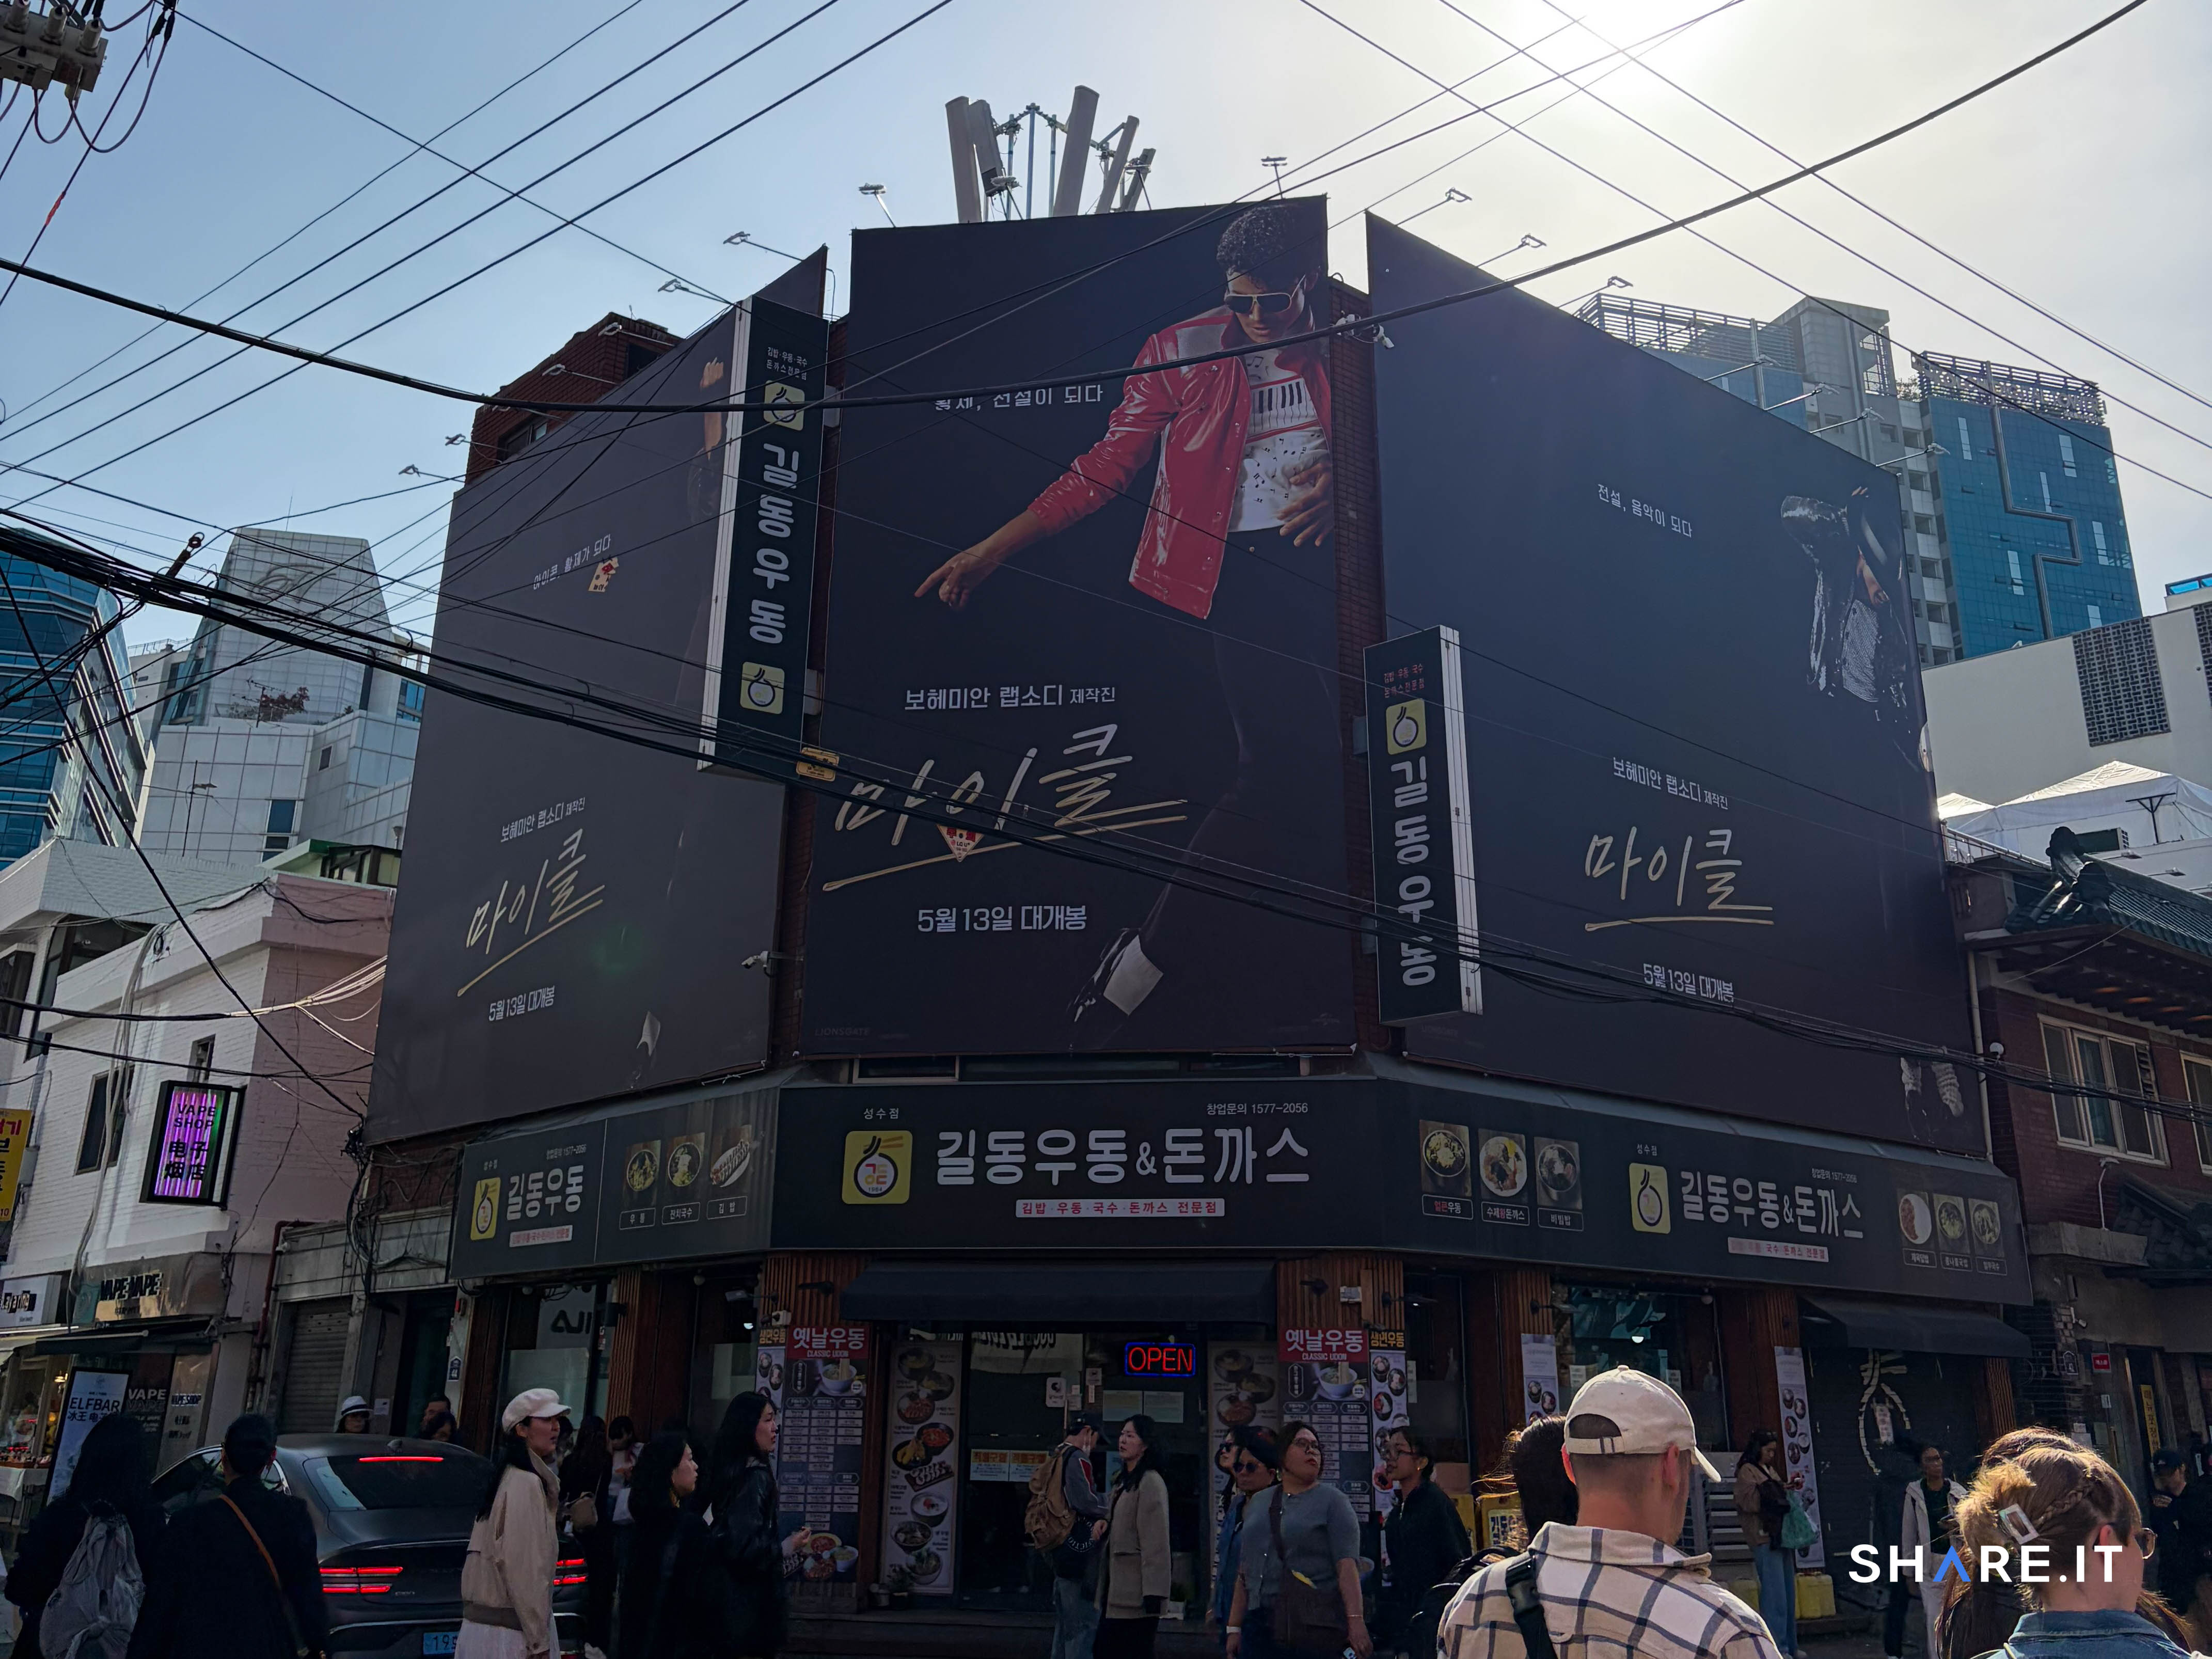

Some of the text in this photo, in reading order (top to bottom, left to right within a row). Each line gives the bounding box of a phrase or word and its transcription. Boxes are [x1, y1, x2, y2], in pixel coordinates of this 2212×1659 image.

[1064, 384, 1103, 404] 되다
[1598, 484, 1693, 538] 전설, 음악이 되다
[564, 545, 590, 572] 황제가
[593, 533, 611, 557] 되다
[749, 443, 799, 644] 길동우동
[905, 685, 1115, 711] 보헤미안 랩소디 제작진
[835, 724, 1188, 845] 마이클
[1613, 757, 1728, 810] 보헤미안 랩소디 제작진
[501, 797, 586, 843] 보헤미안 랩소디 제작진
[1585, 827, 1773, 910] 마이클
[466, 828, 605, 954] 마이클
[1021, 905, 1087, 930] 대개봉
[527, 985, 555, 1012] 대개봉
[1699, 975, 1734, 1003] 대개봉
[178, 1103, 216, 1117] VAPE
[863, 1108, 899, 1119] 성수점
[1206, 1102, 1308, 1115] 창업문의 1577-2056
[174, 1118, 214, 1129] SHOP
[169, 1139, 209, 1159] 电子
[937, 1127, 1310, 1186] 길동우동&돈까스
[1636, 1144, 1657, 1157] 성수점
[507, 1165, 584, 1221] 길동우동
[1681, 1171, 1863, 1238] 길동우동&돈까스
[1022, 1201, 1218, 1214] 김밥 우동 국수 돈까스 전문점
[1551, 1213, 1571, 1227] 비빔밥
[793, 1328, 865, 1350] 옛날우동
[1286, 1330, 1363, 1352] 옛날우동
[1128, 1347, 1193, 1372] OPEN
[70, 1397, 120, 1413] ELFBAR
[129, 1388, 167, 1400] VAPE
